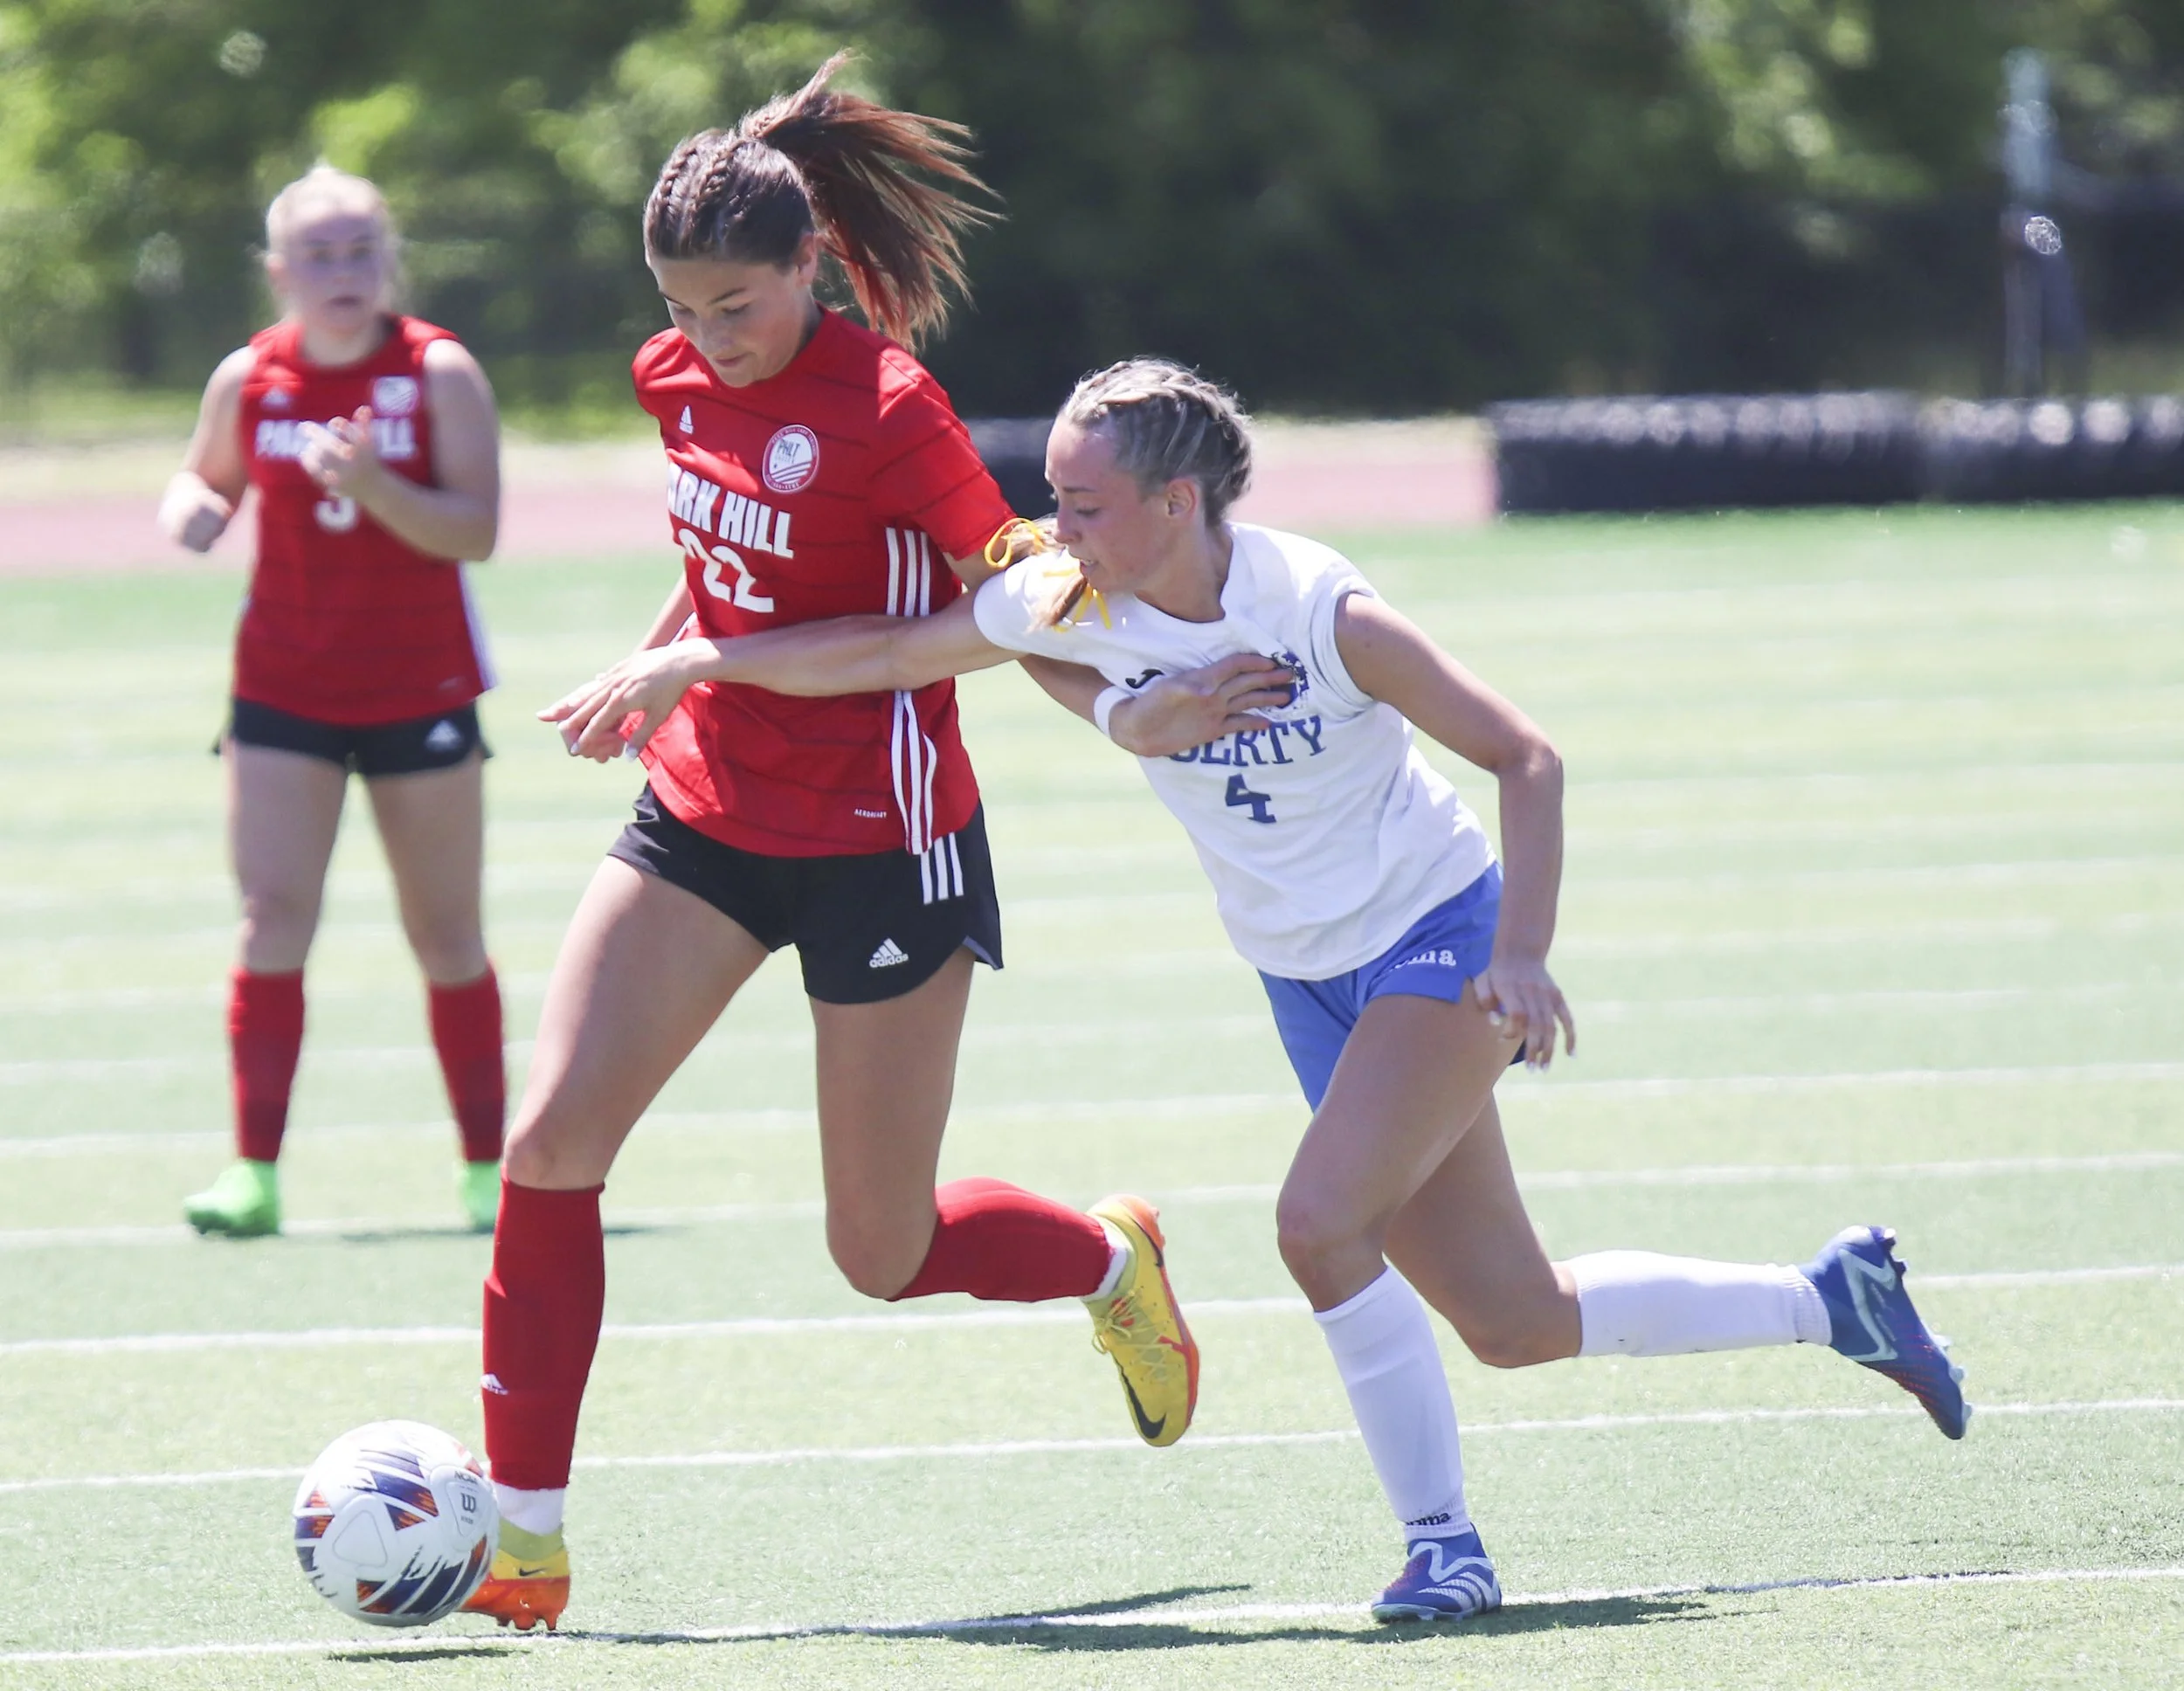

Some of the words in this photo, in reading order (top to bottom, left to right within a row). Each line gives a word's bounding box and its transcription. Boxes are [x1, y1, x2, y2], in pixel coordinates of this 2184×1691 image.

[667, 461, 721, 534] ARK
[718, 491, 794, 560] HILL
[678, 528, 775, 613] 22
[1171, 714, 1327, 767] ERTY
[1225, 773, 1277, 824] 4
[869, 954, 909, 968] adidas
